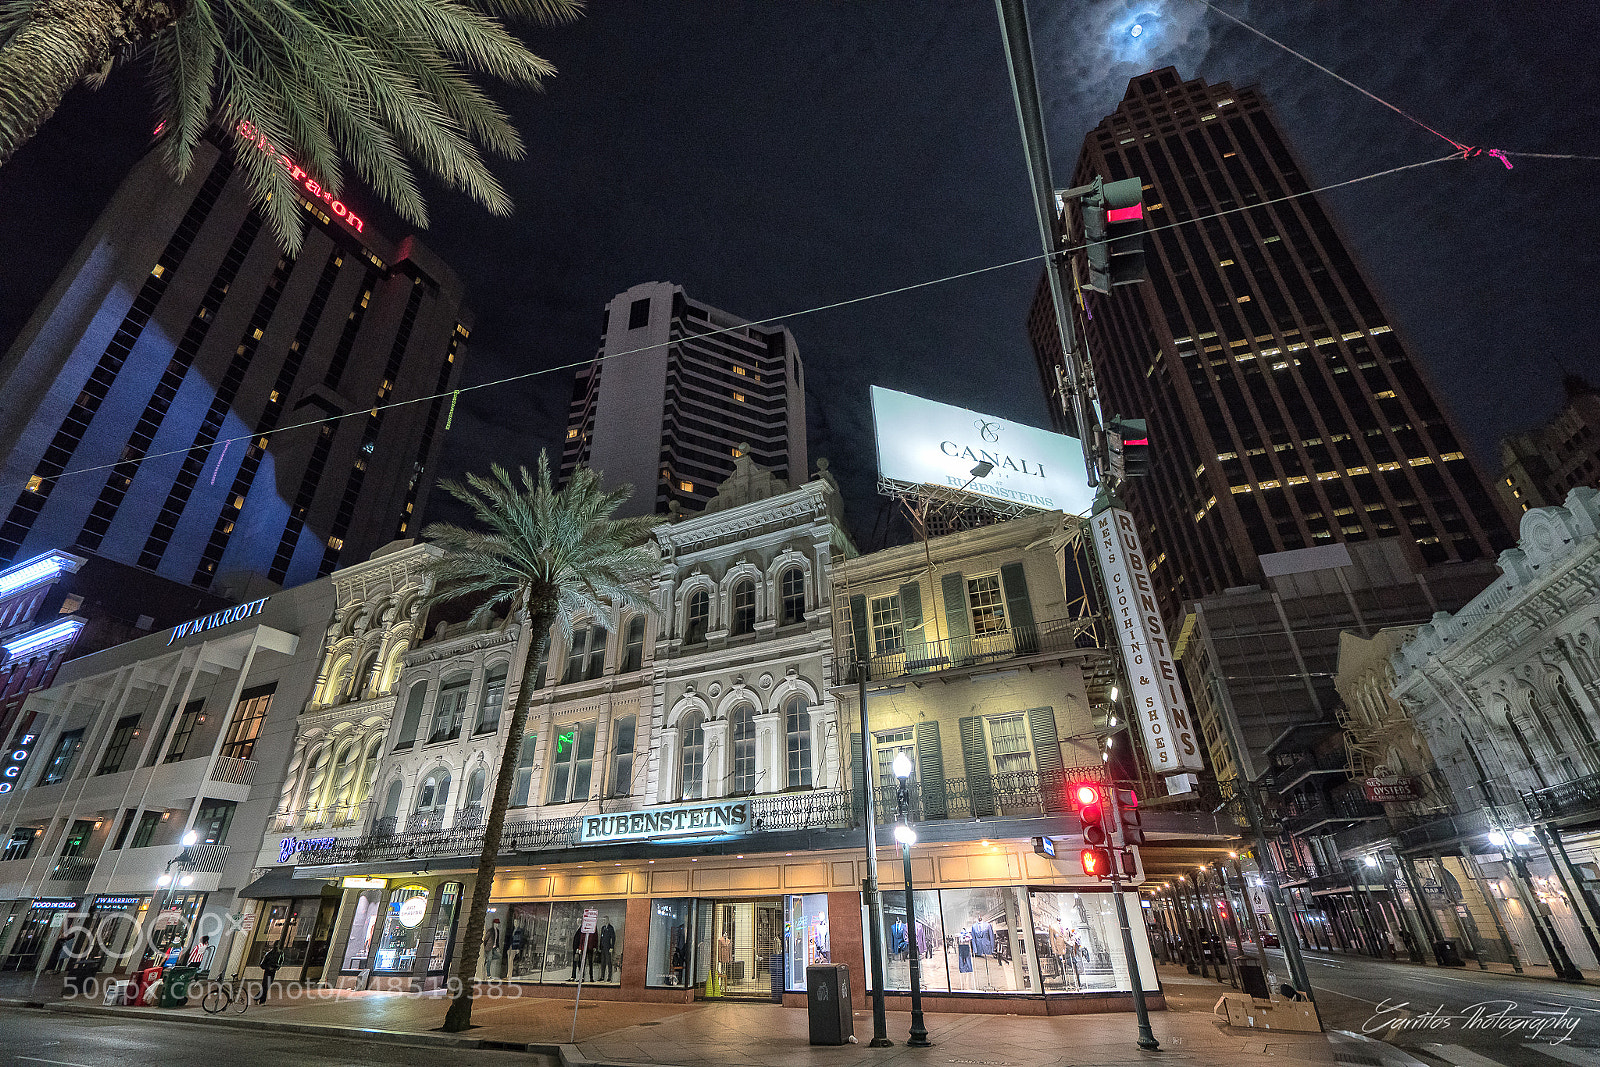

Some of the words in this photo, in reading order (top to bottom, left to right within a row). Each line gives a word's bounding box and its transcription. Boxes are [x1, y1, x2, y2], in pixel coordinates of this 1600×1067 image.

[940, 440, 1047, 478] CANALI
[946, 475, 1054, 507] RUBENSTEINS
[166, 621, 193, 647] JW
[190, 596, 270, 635] MARRIOTT
[1118, 514, 1196, 757] RUBENSTEINS
[1113, 573, 1143, 665] CLOTHING
[1139, 675, 1150, 686] &
[1146, 697, 1168, 763] SHOES
[0, 734, 35, 794] FOGO
[1374, 786, 1412, 796] OYSTERS
[585, 803, 747, 838] RUBENSTEINS
